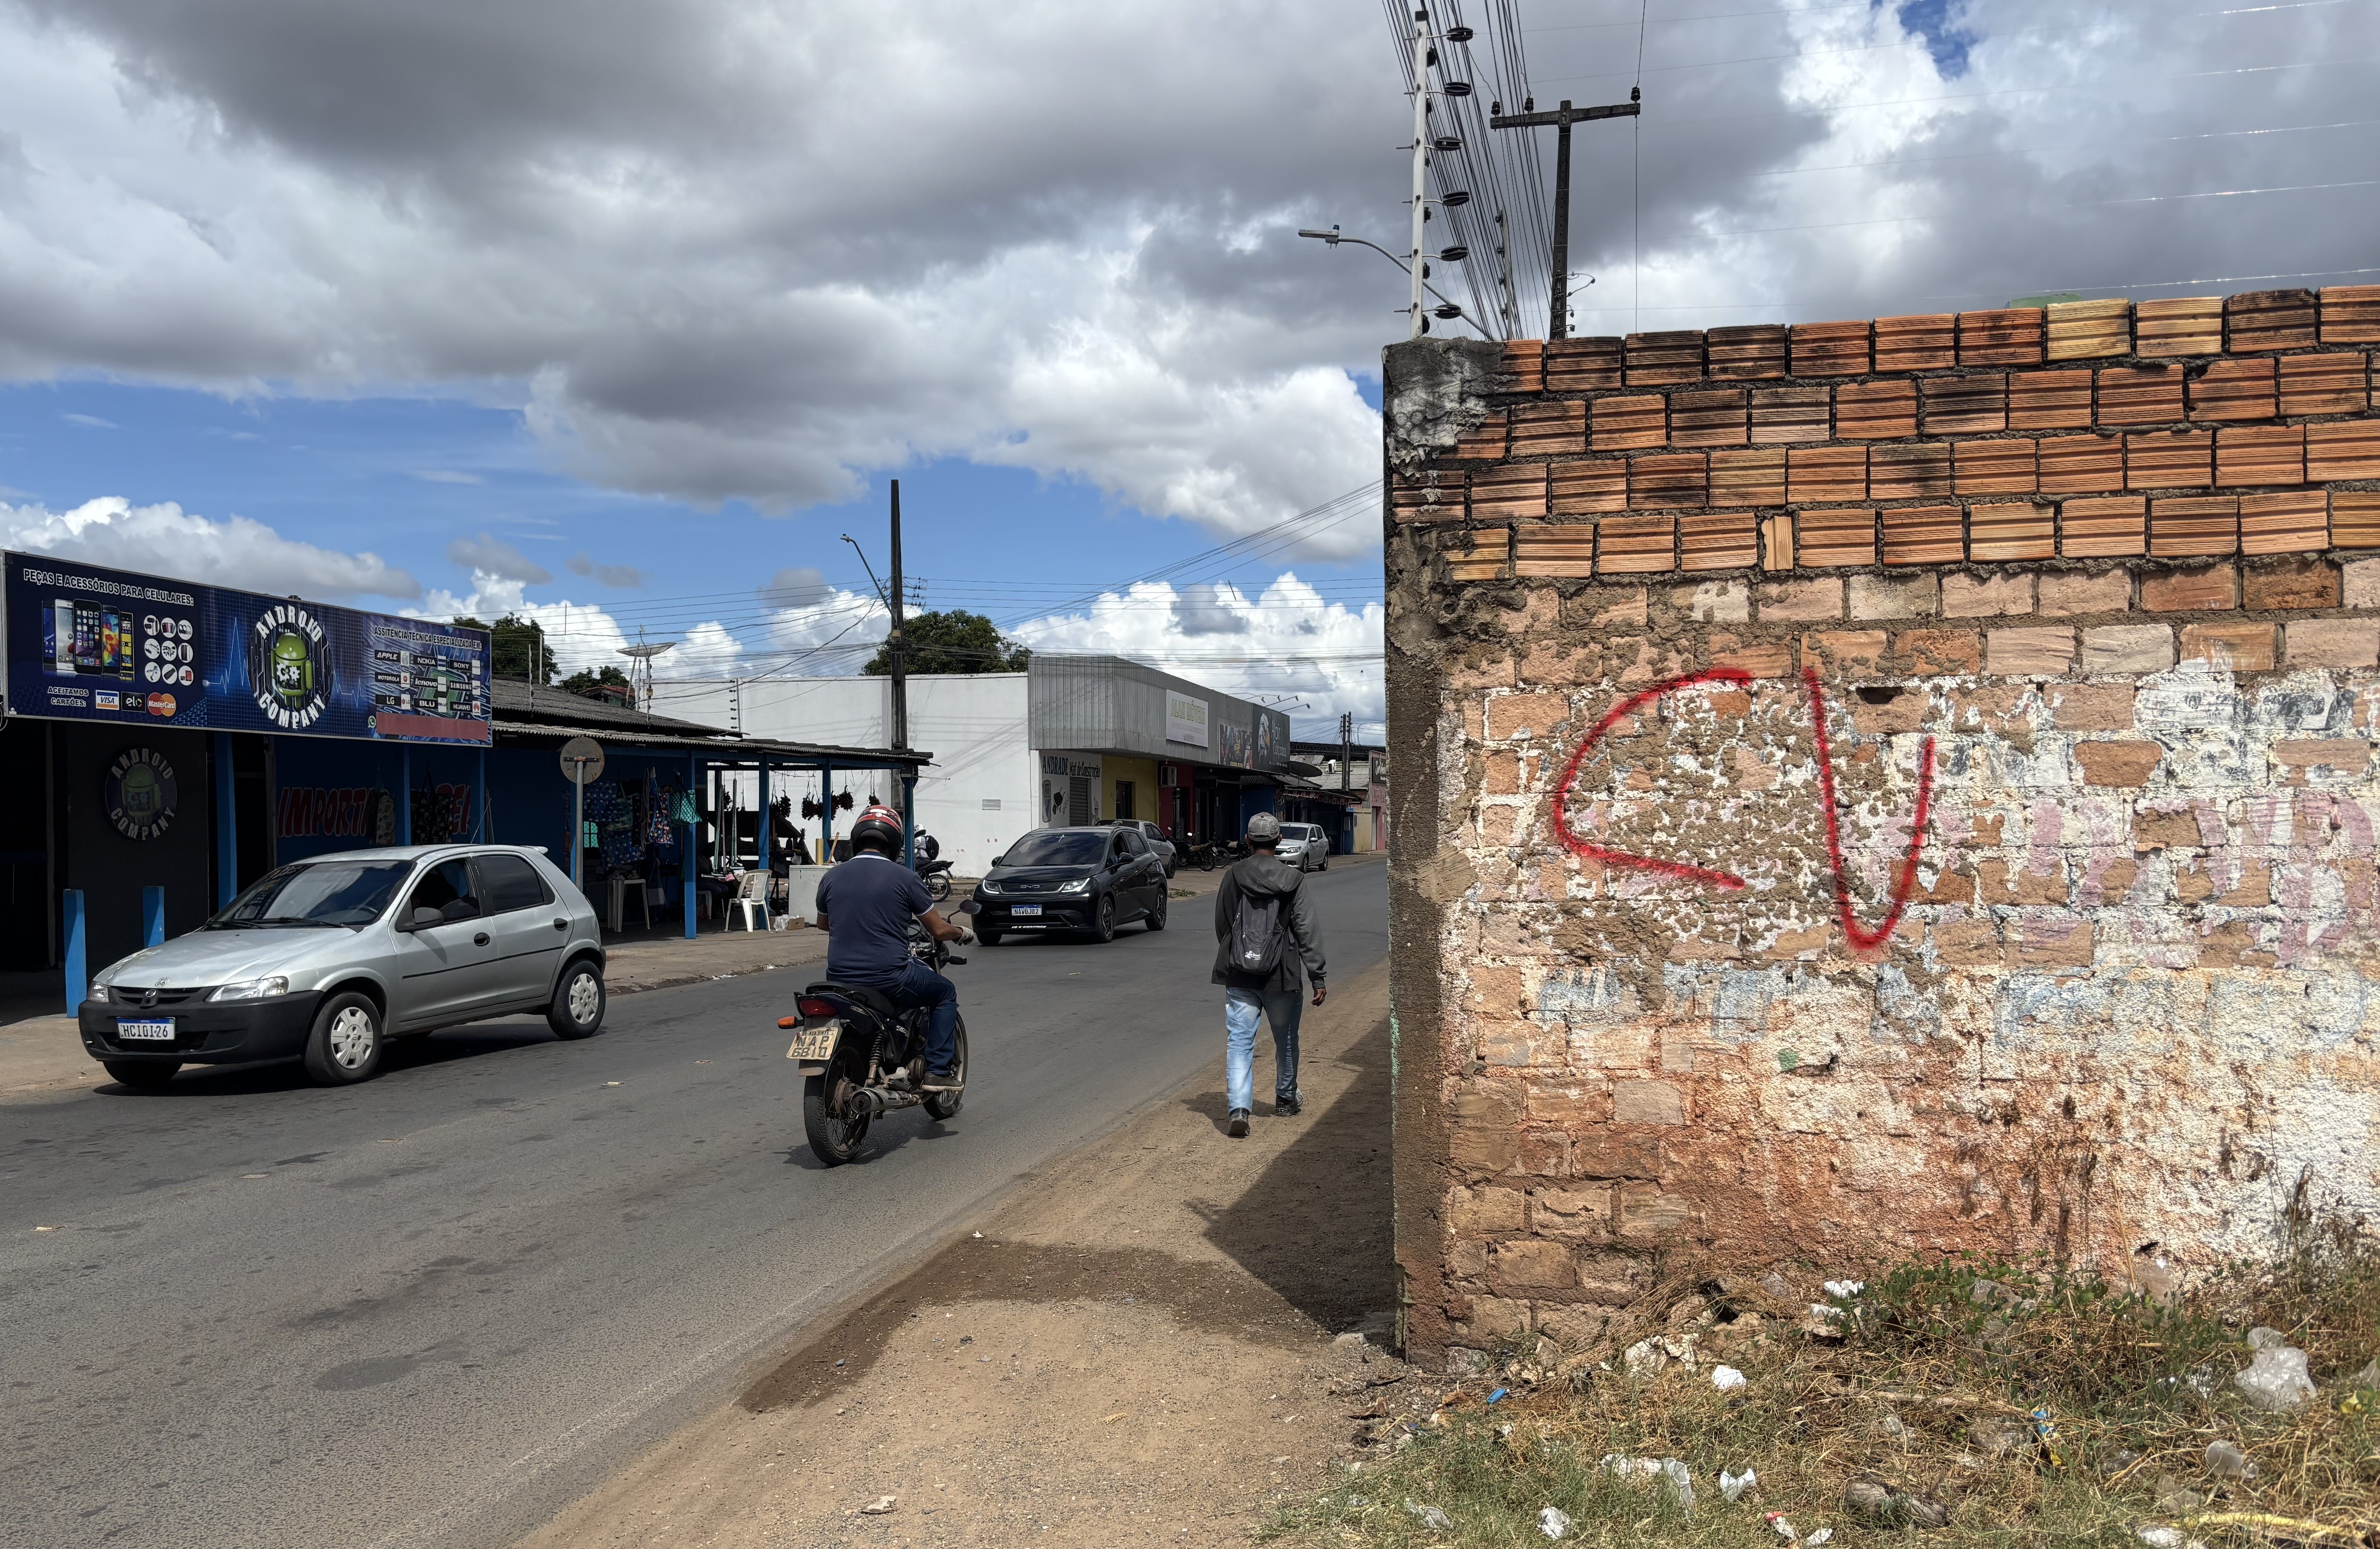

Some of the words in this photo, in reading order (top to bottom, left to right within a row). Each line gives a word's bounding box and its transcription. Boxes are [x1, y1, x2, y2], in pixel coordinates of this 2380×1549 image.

[23, 568, 54, 585] PEÇAS
[56, 573, 63, 586] E
[64, 575, 120, 595] ACESSÓRIOS
[121, 584, 144, 599] PARA
[144, 588, 194, 606] CELULARES:
[256, 604, 323, 642] ANDROID
[433, 634, 473, 649] ESPECIALIZADA
[377, 652, 398, 660] APPLE
[453, 661, 470, 669] SONY
[415, 678, 438, 687] lenovo
[47, 686, 89, 697] ACEITAMOS
[100, 696, 115, 704] VISA
[149, 700, 176, 709] MasterCard
[387, 696, 395, 704] LG
[259, 693, 326, 729] COMPANY
[111, 748, 173, 779] ANDROID
[1043, 756, 1068, 776] ANDRADE
[110, 806, 175, 840] COMPANY
[797, 1036, 830, 1047] NAP
